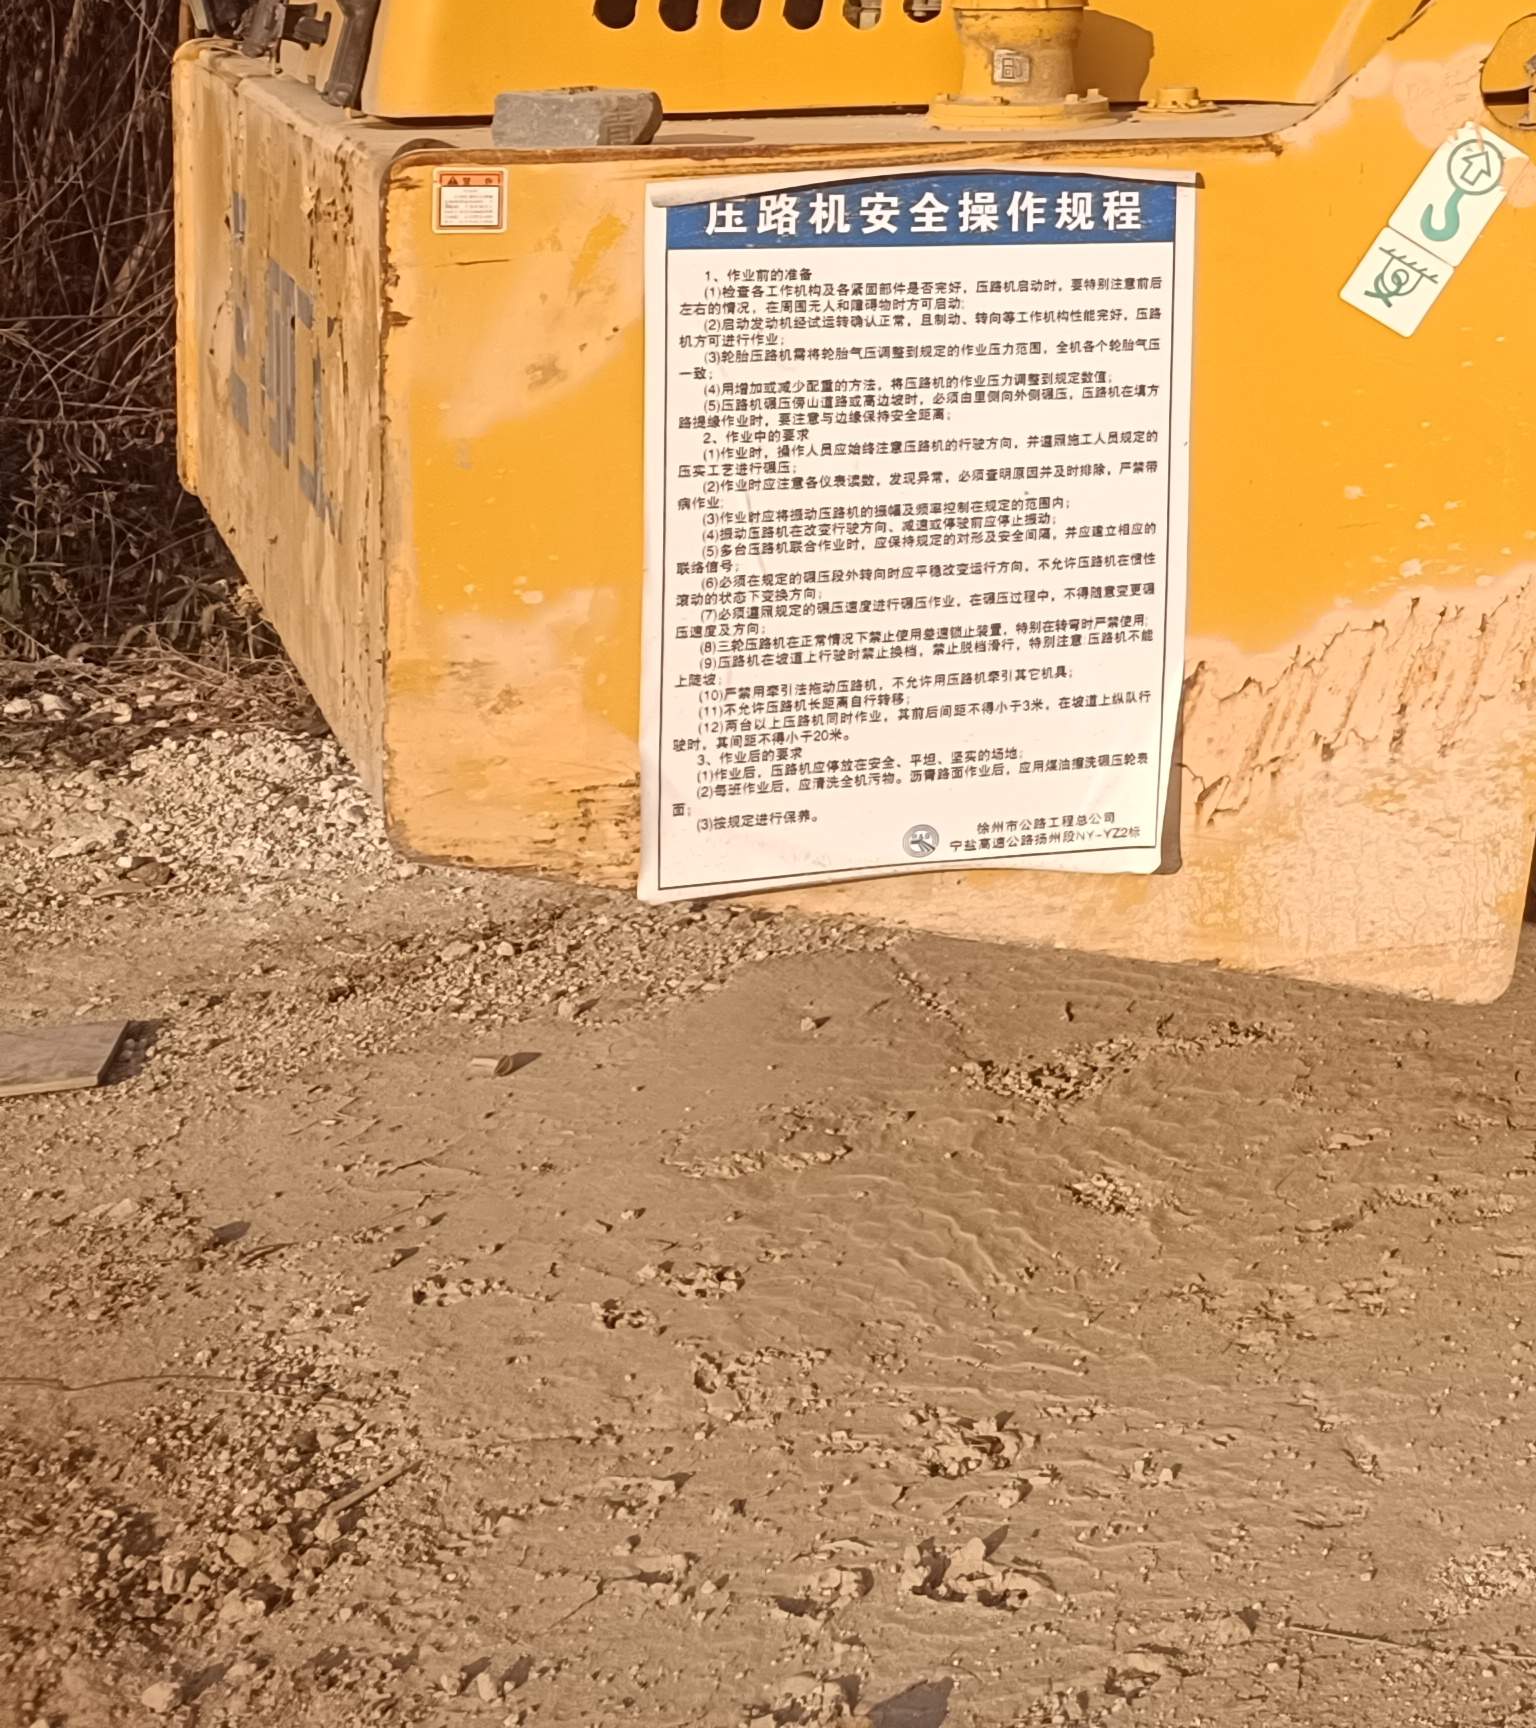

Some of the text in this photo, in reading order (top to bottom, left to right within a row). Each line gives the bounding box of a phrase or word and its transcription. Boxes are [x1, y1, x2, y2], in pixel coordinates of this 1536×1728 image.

[705, 190, 1142, 237] 压路机安全操作规程
[977, 812, 1115, 834] 徐州市公路工程总公司
